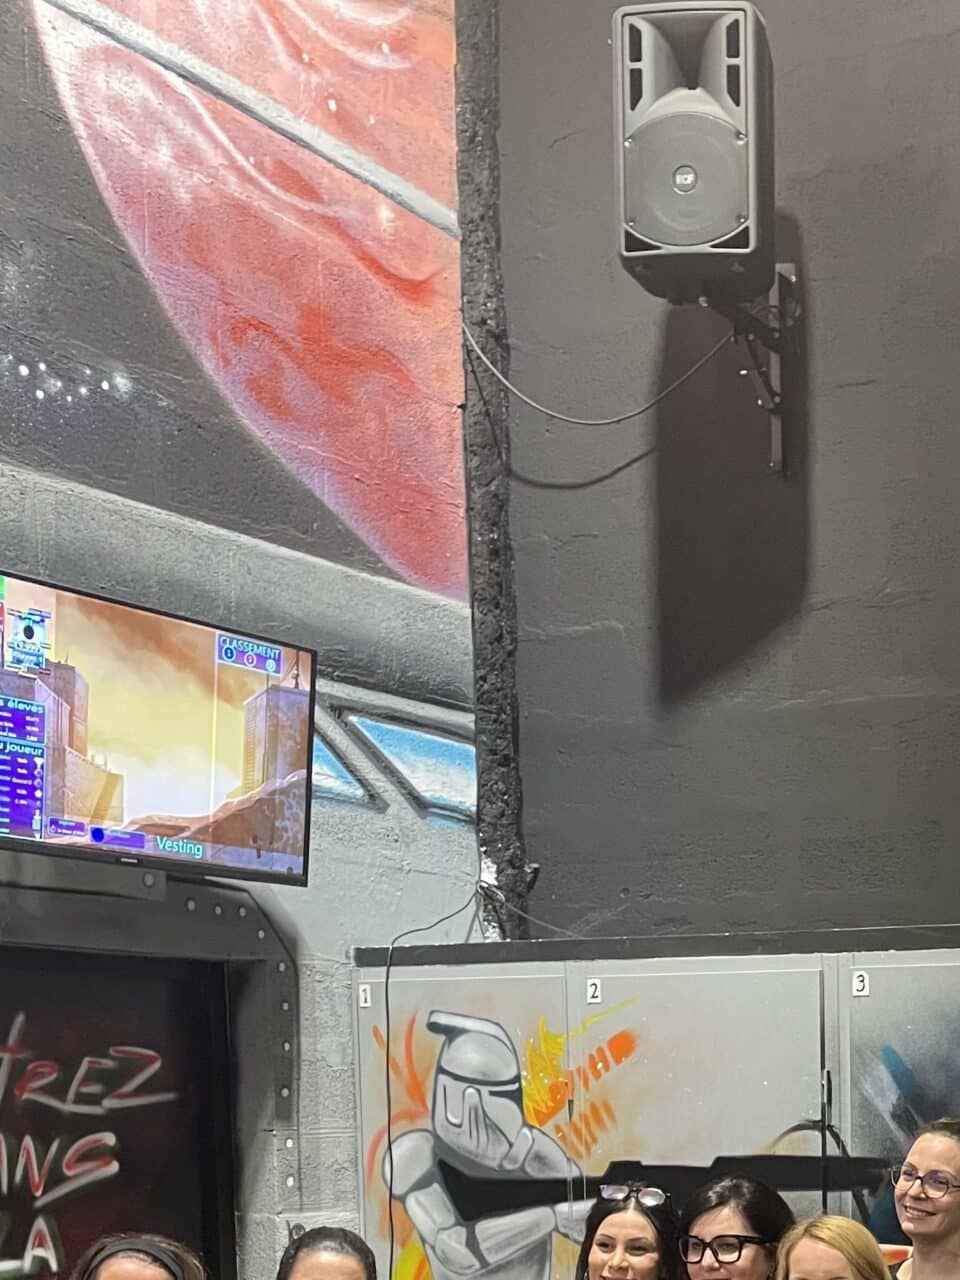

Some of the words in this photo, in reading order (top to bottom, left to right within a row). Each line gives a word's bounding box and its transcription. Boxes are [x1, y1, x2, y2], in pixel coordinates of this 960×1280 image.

[220, 636, 280, 661] CLASSEMENT
[4, 741, 43, 756] joueur
[156, 836, 203, 858] Vesting
[590, 983, 599, 999] 2
[856, 974, 866, 992] 3
[361, 988, 368, 1004] 1
